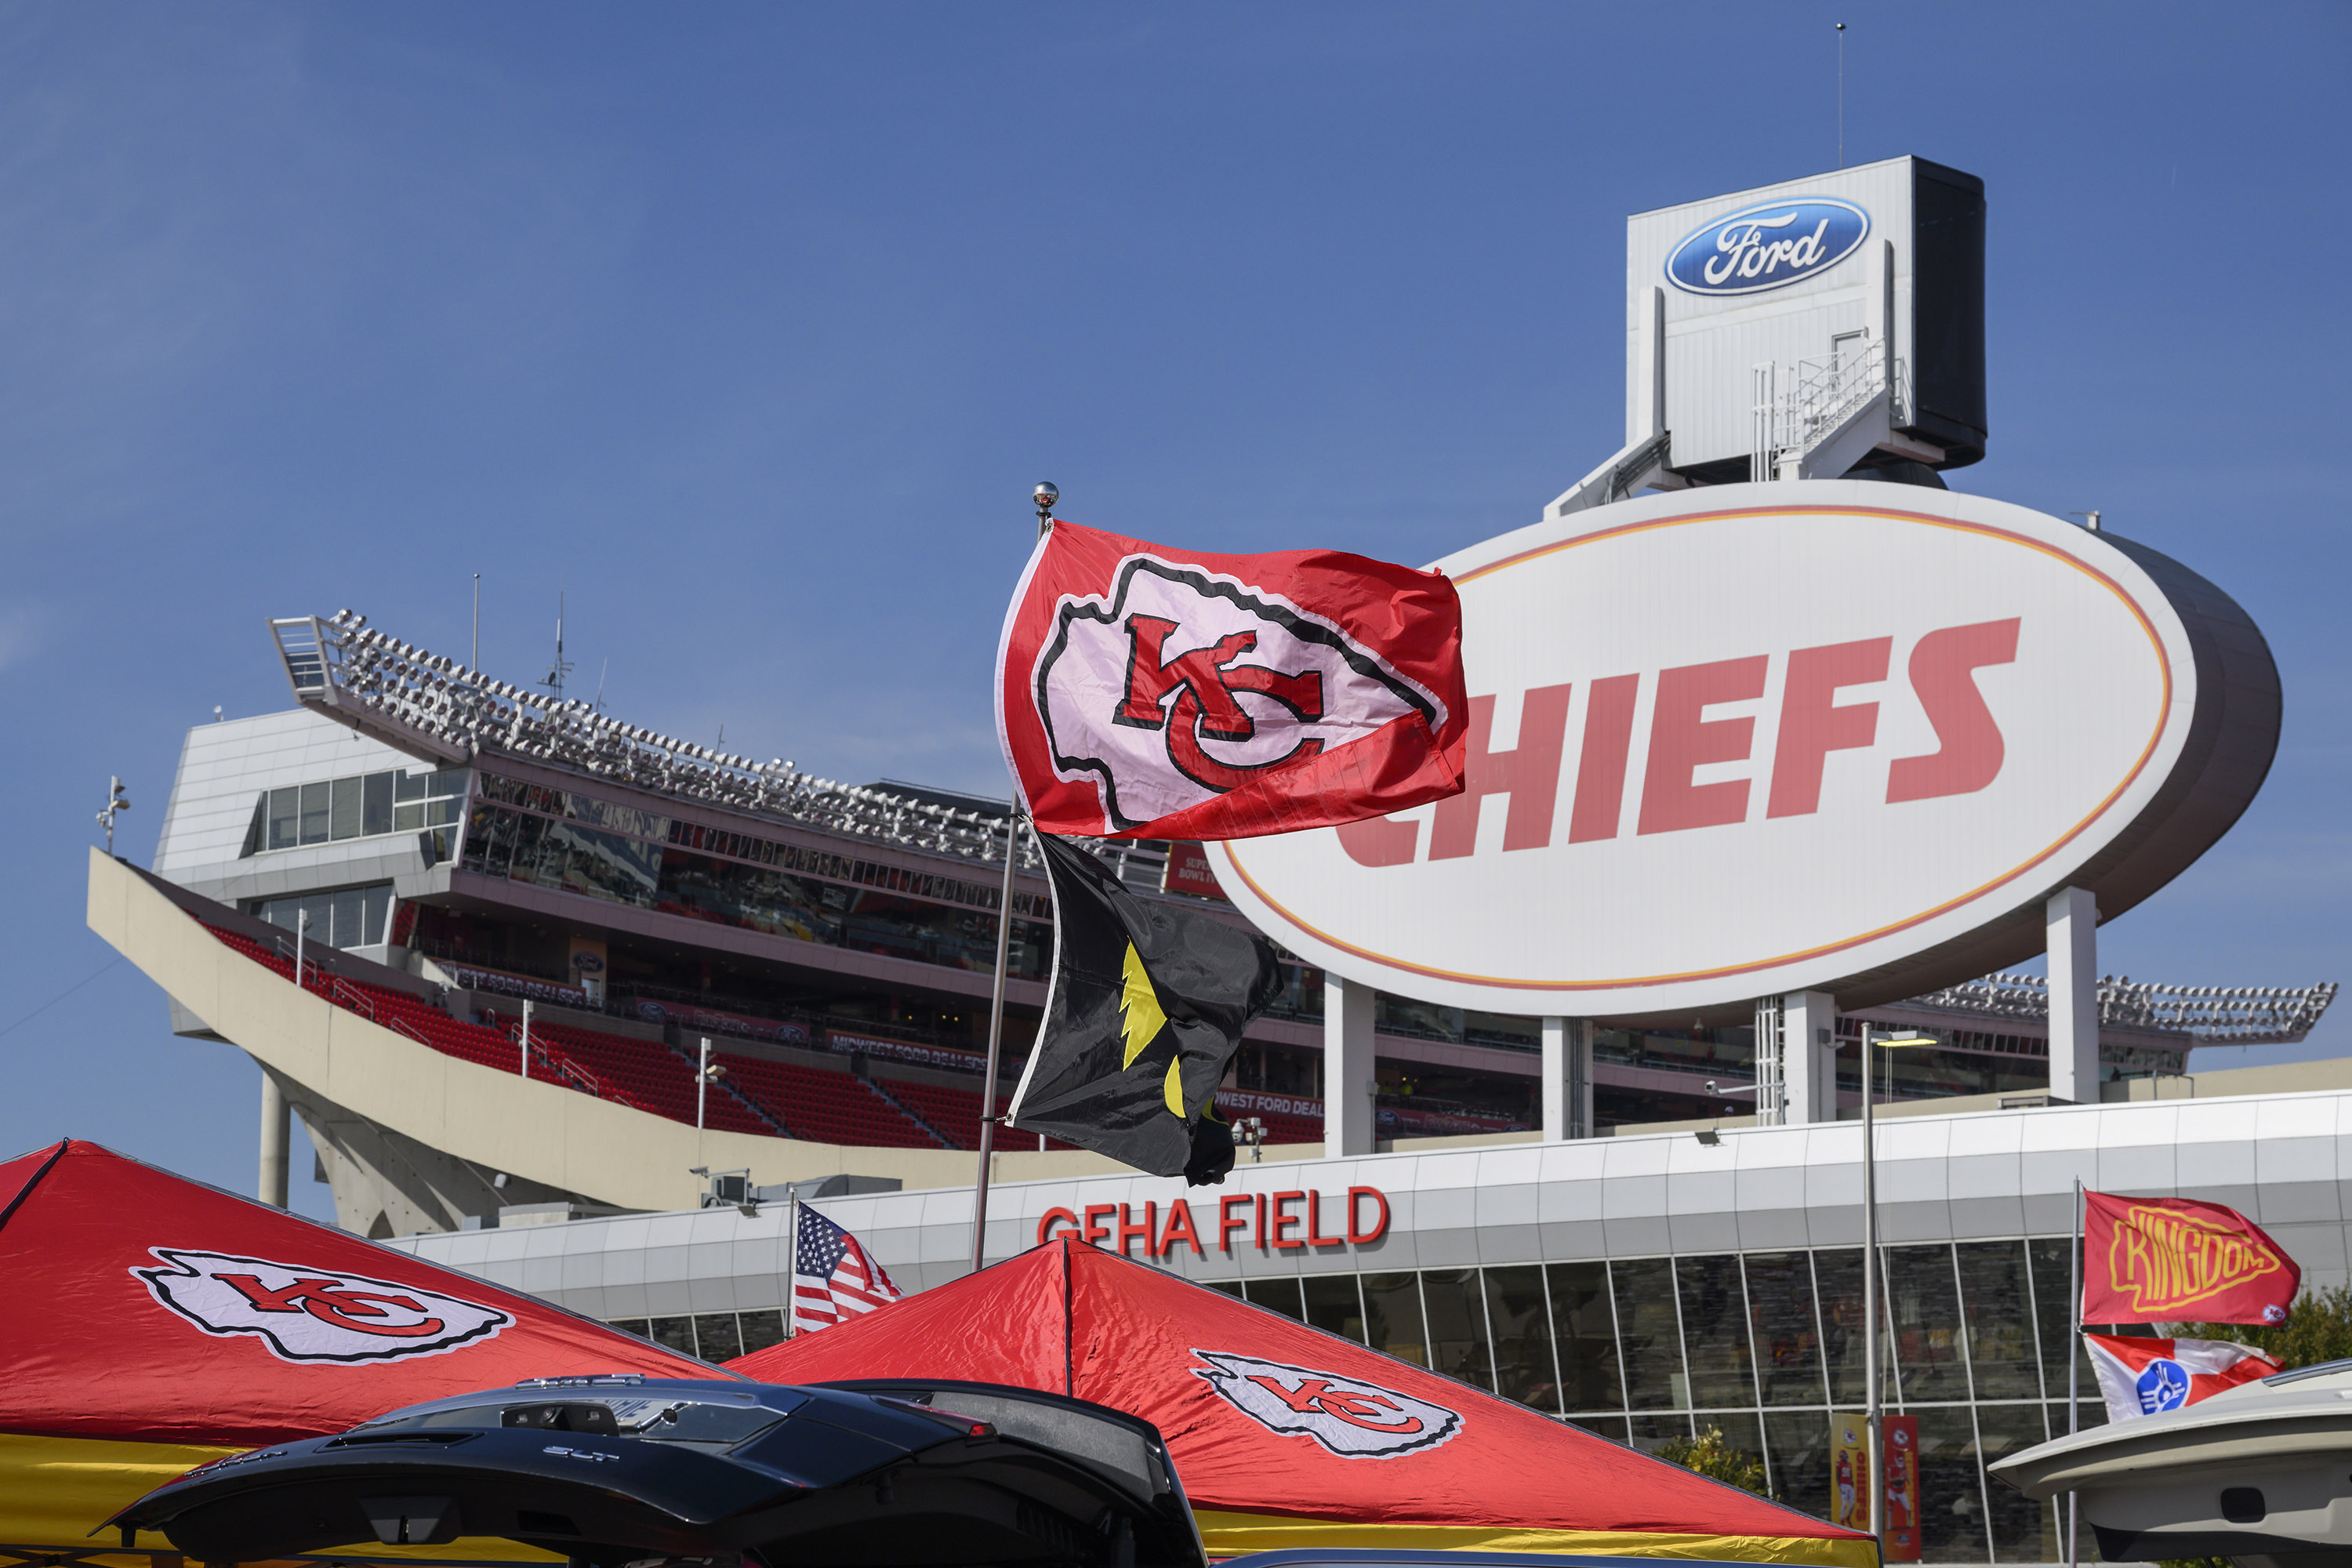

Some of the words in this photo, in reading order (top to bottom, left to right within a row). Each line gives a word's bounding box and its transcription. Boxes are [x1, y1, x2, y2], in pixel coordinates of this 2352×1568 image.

[1704, 212, 1830, 285] Ford
[1112, 613, 1325, 793] KC
[1334, 616, 2022, 867] HIEFS
[1178, 868, 1204, 883] BOWL
[832, 1035, 894, 1056] MIDWEST
[1256, 1096, 1291, 1113] FORD
[1292, 1100, 1325, 1117] DEAL
[1037, 1198, 1203, 1256] GEHA
[1219, 1185, 1388, 1252] FIELD
[2126, 1213, 2265, 1301] KINGDOM
[210, 1273, 445, 1338] KC
[1244, 1374, 1425, 1434] KC
